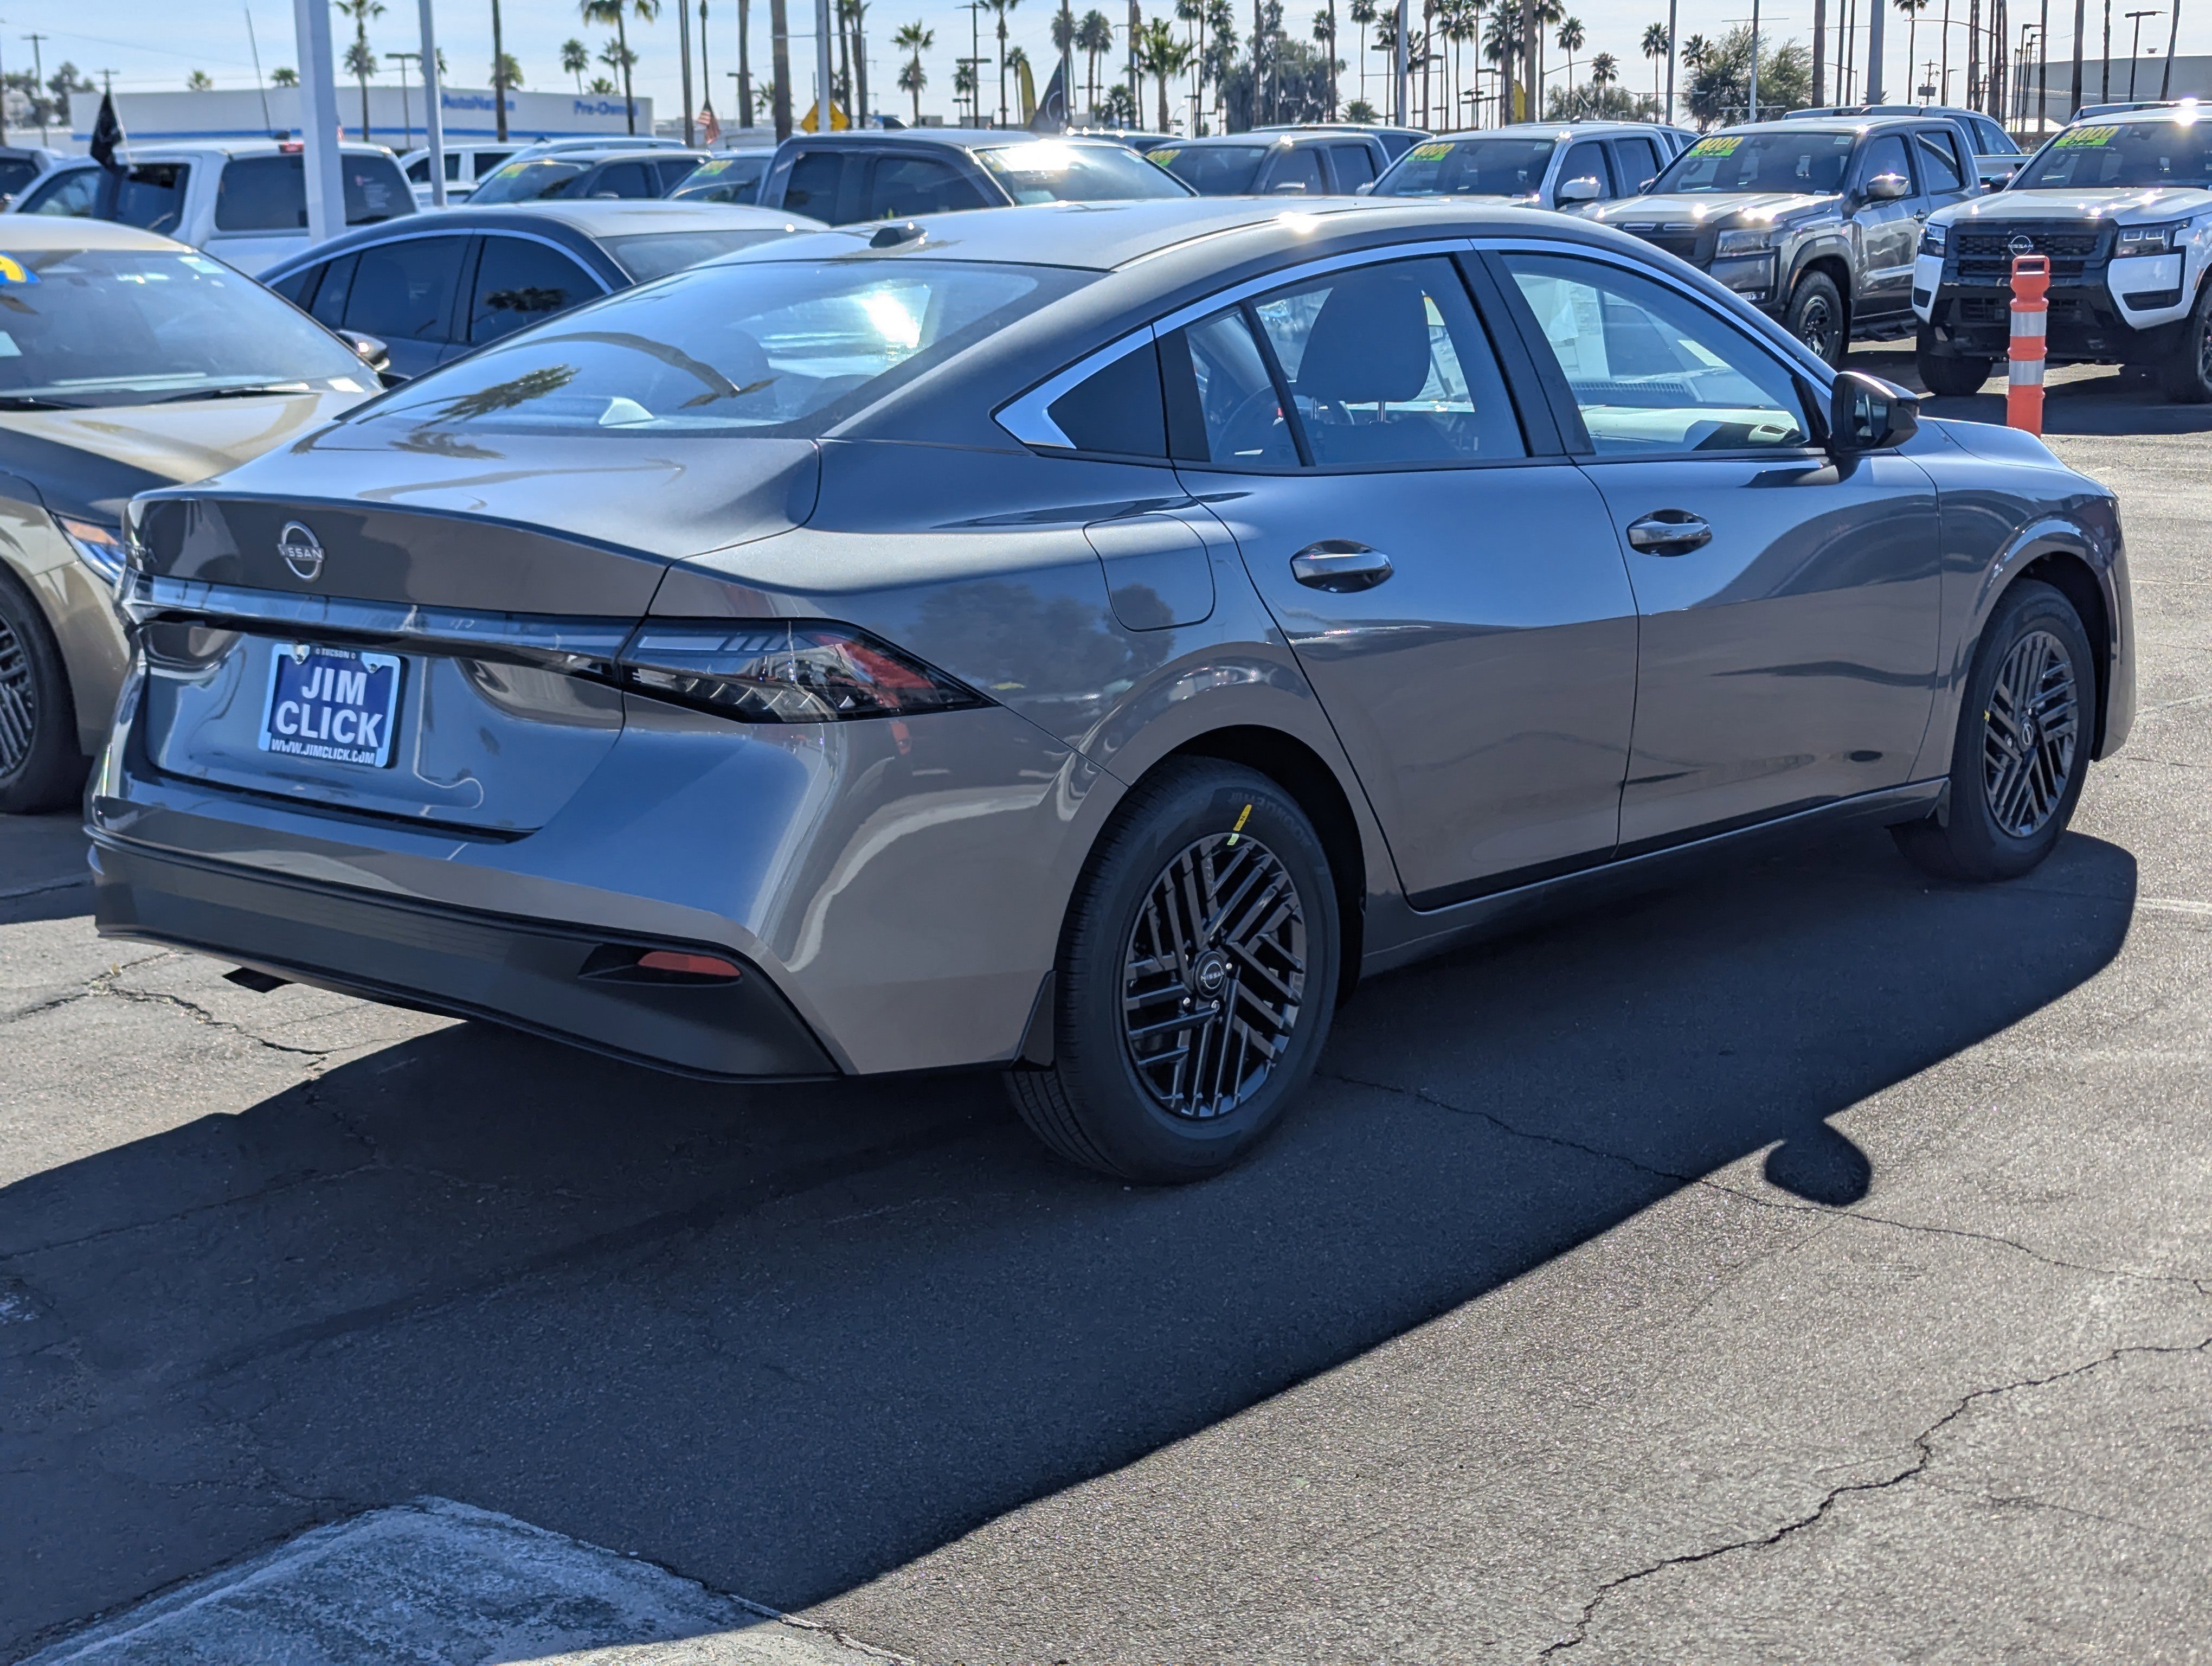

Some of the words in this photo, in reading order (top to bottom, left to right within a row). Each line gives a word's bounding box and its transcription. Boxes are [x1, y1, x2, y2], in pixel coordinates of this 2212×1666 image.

[301, 666, 368, 706] JIM
[276, 700, 383, 748] CLICK
[271, 738, 376, 765] WWW.JIMCLICK.COM
